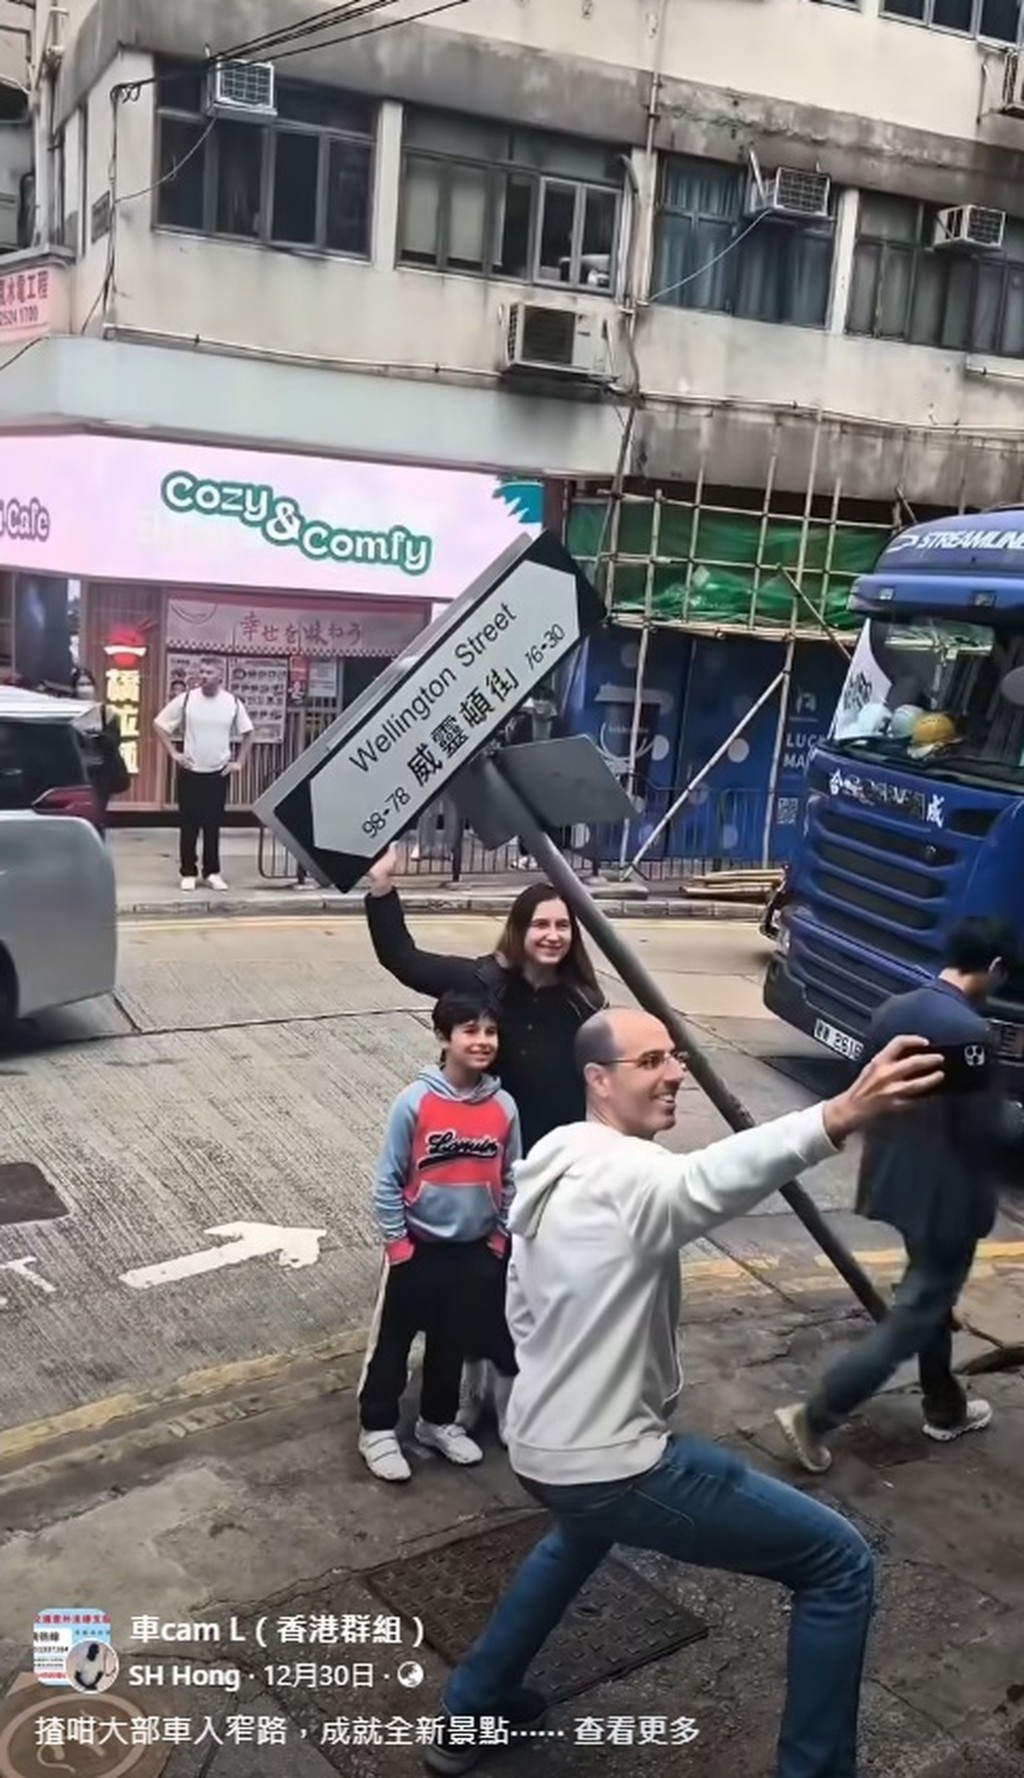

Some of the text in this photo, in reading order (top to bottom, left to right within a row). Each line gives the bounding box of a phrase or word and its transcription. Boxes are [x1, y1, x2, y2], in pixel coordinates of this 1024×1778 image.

[6, 497, 50, 541] Cafe
[162, 471, 272, 525] Cozy
[262, 498, 303, 545] &
[301, 521, 431, 575] Comfy
[349, 602, 517, 772] Wellington Street
[407, 668, 520, 787] 威靈頓街
[362, 787, 411, 838] 98-78
